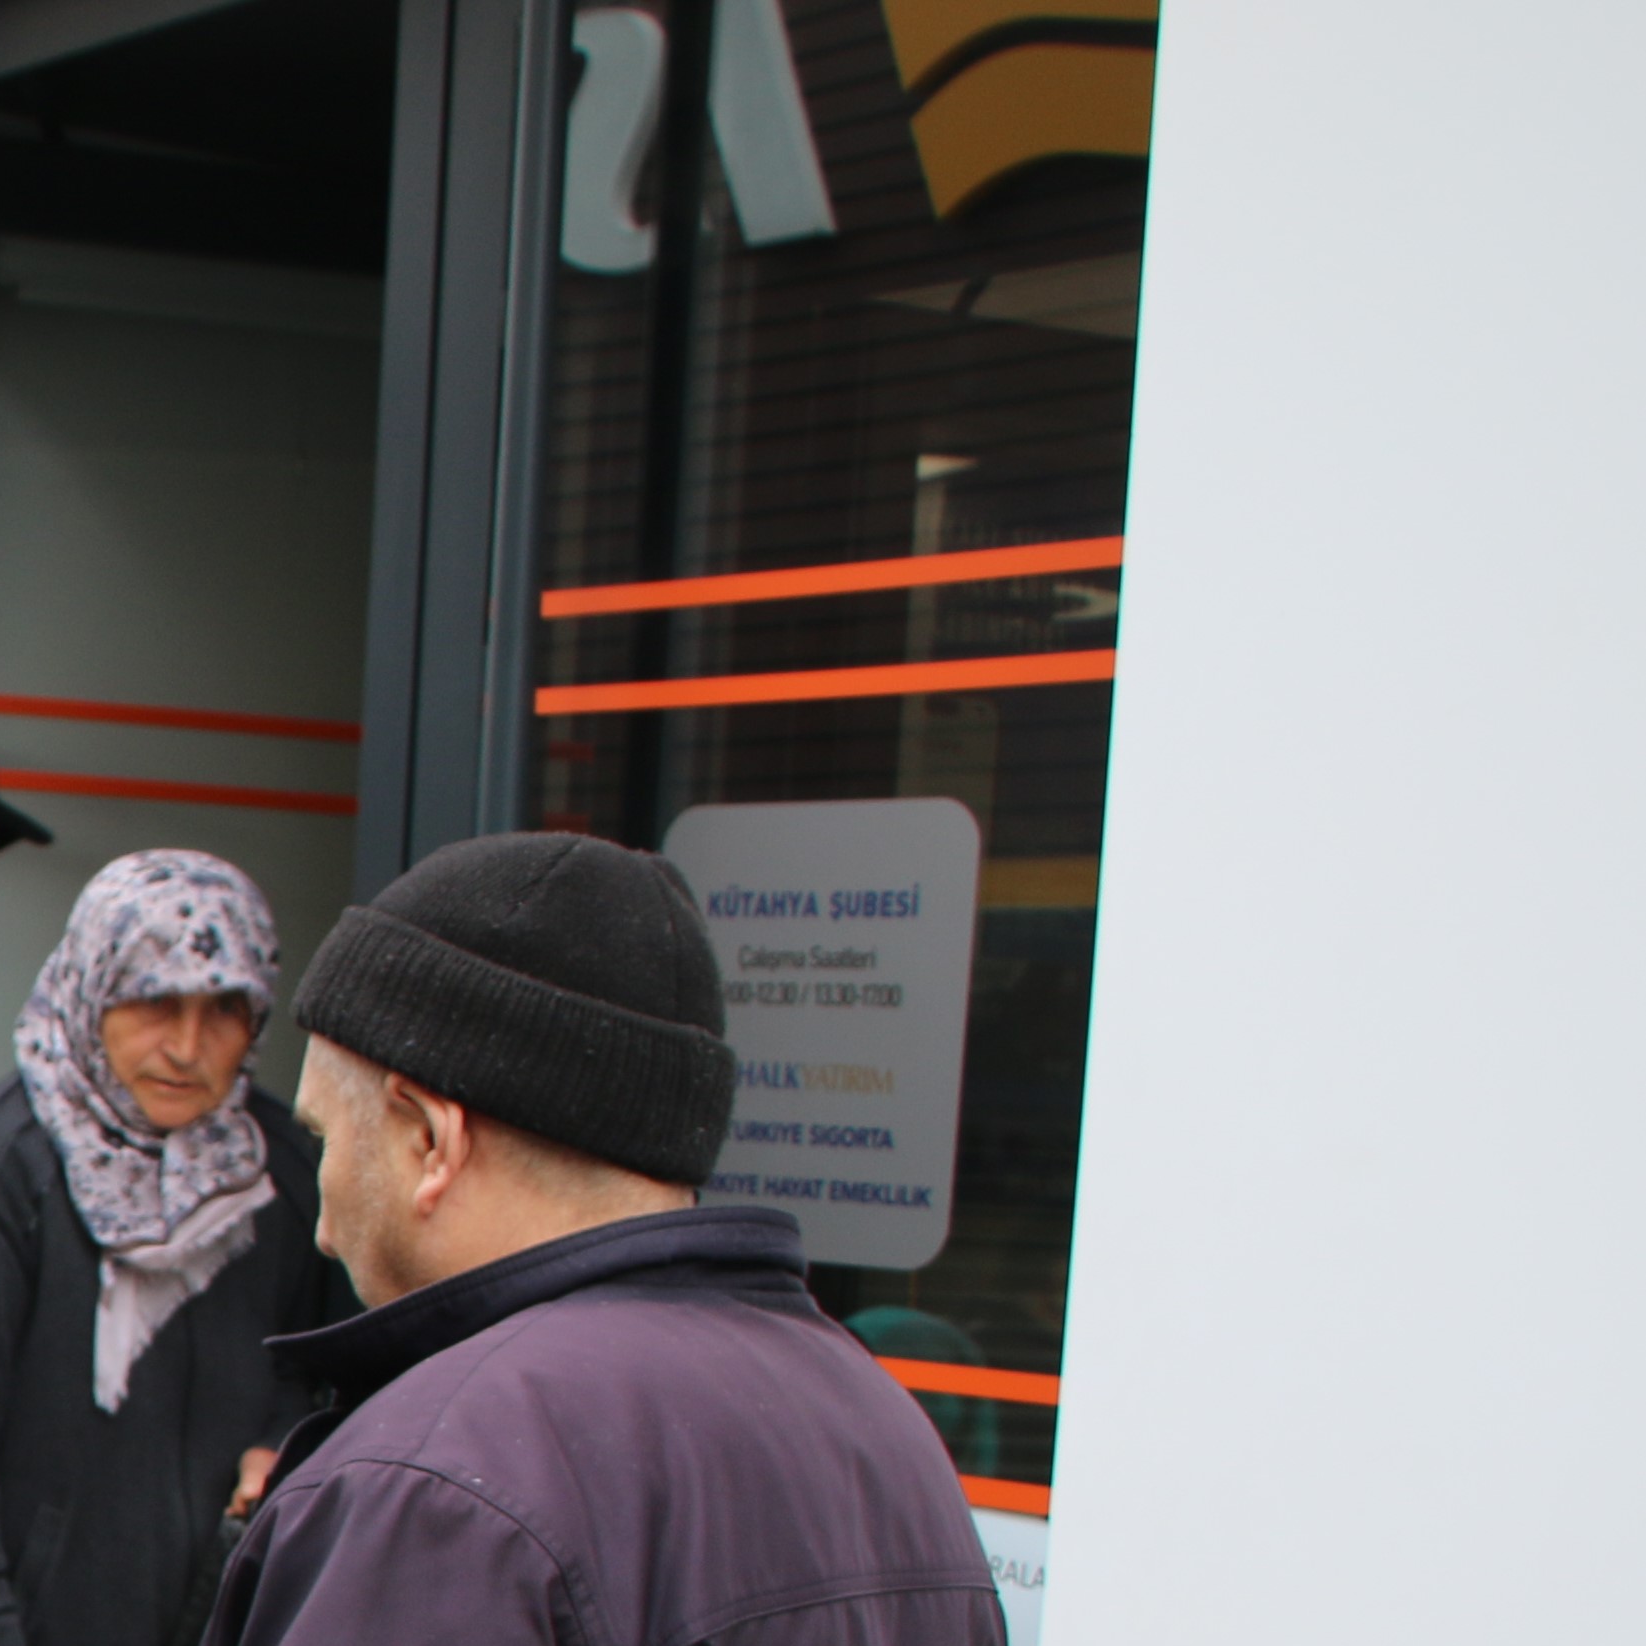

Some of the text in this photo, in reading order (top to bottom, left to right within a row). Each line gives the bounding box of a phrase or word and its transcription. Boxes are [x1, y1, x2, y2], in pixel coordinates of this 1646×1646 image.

[708, 882, 920, 919] KÜTAHYA ŞUBESİ
[738, 945, 877, 971] Çalışma Saatleri
[763, 1176, 823, 1199] HAYAT
